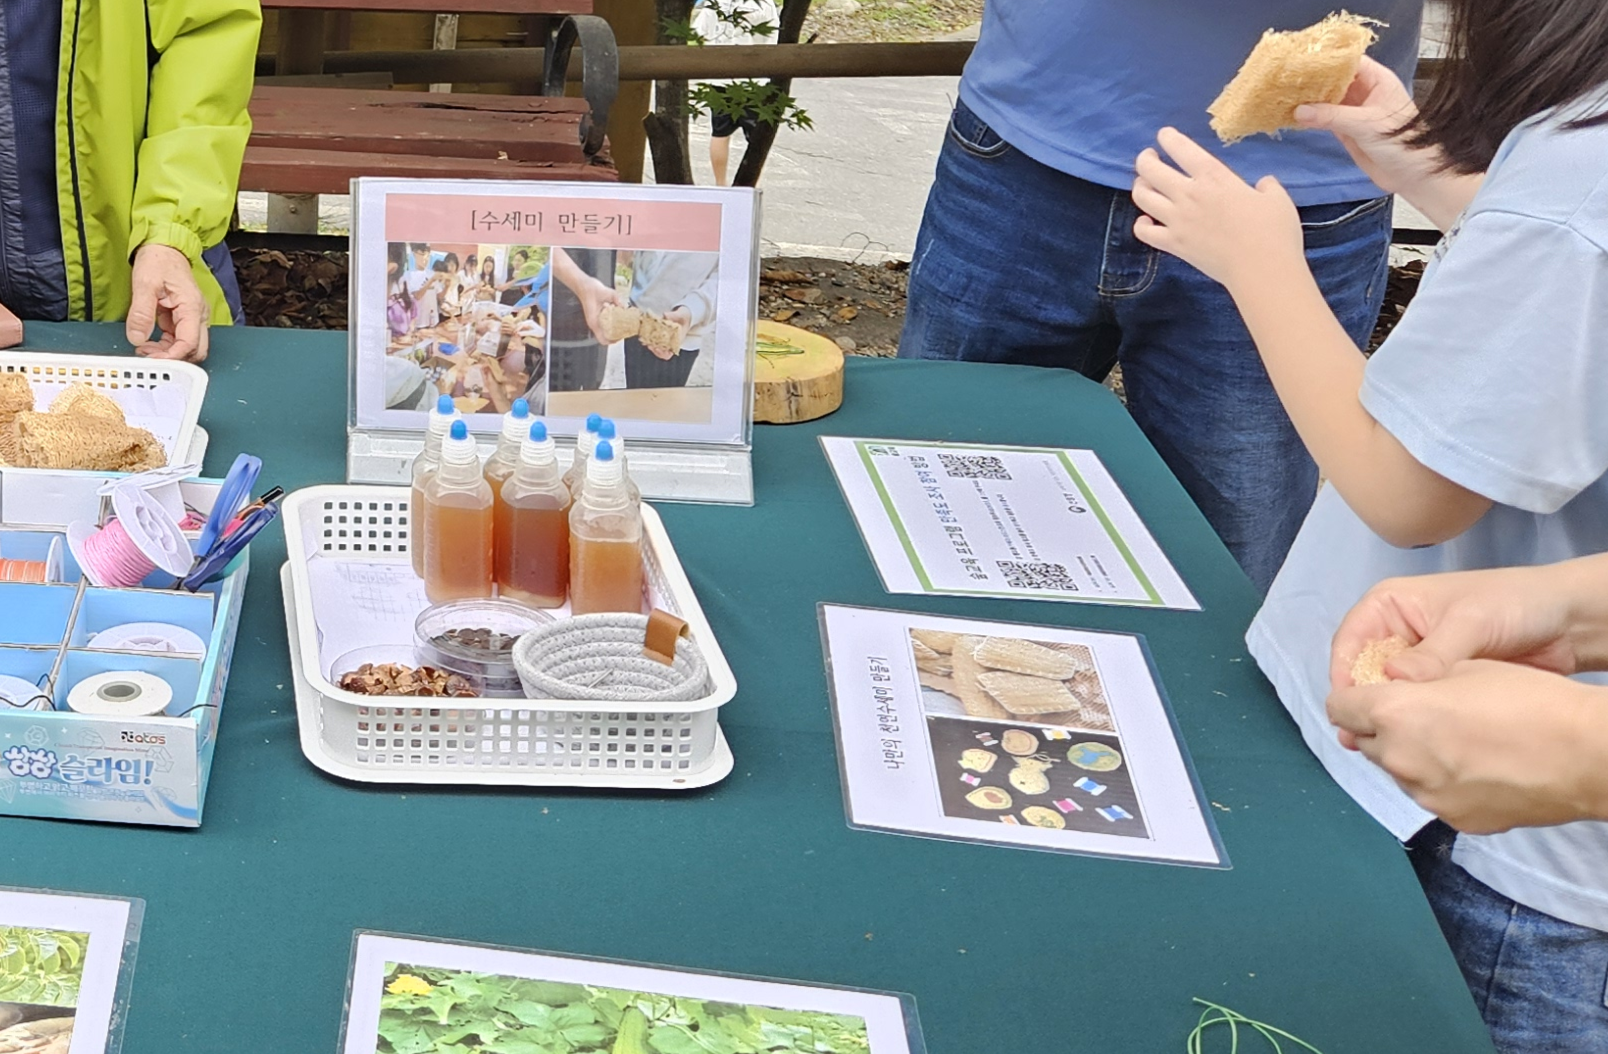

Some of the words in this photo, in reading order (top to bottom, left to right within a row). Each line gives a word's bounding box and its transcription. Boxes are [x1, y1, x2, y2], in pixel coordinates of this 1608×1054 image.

[470, 209, 544, 233] [수세미
[557, 212, 633, 236] 만들기]
[867, 656, 890, 682] 만들기
[872, 686, 899, 733] 천연수세미
[881, 738, 905, 769] 나만의
[60, 754, 154, 786] 슬라임!
